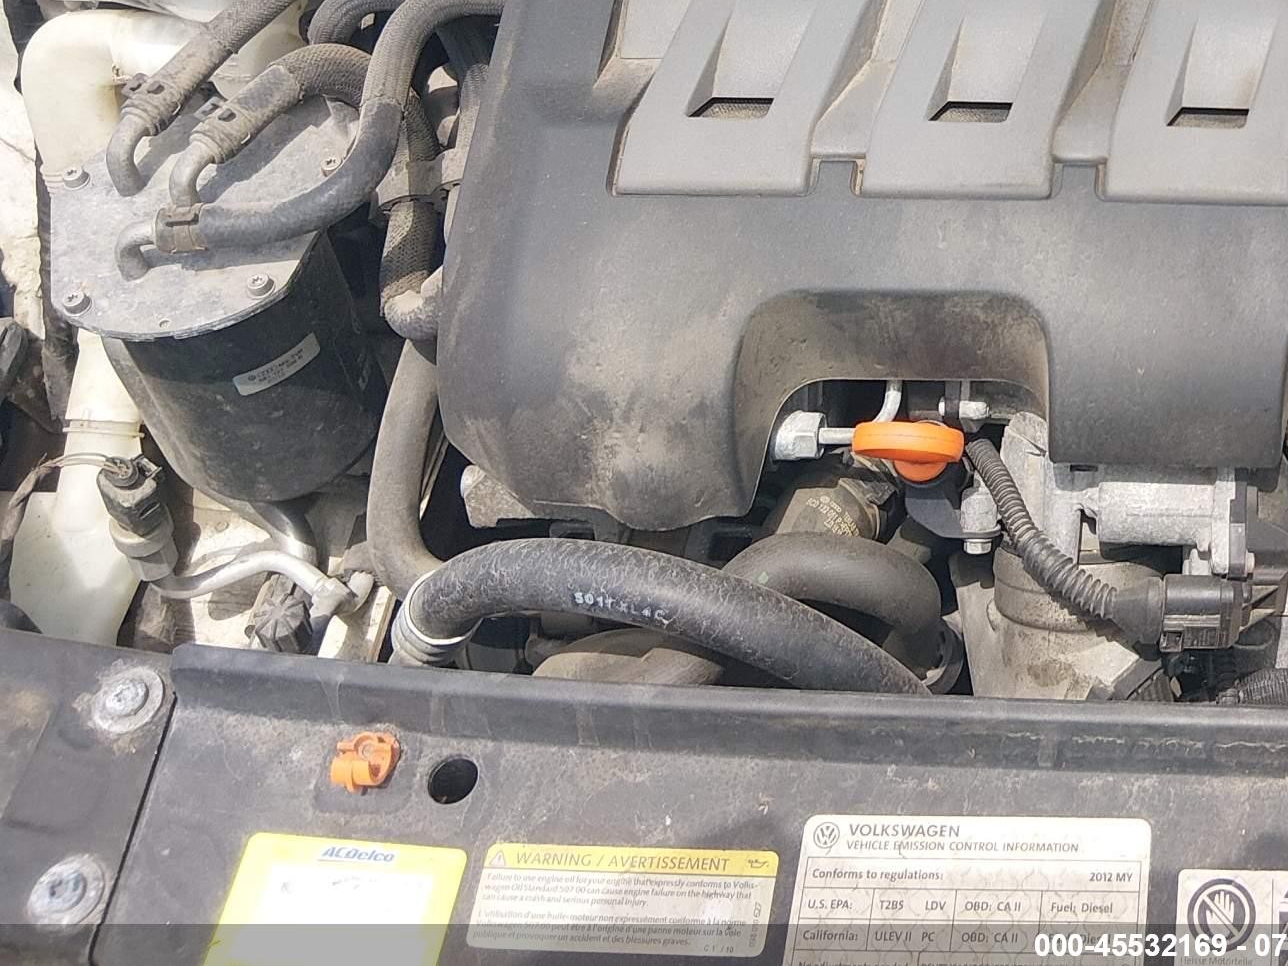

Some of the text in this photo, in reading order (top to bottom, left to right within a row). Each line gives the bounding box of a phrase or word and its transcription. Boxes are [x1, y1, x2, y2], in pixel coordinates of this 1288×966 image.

[849, 824, 960, 837] VOLKSWAGEN
[847, 840, 1079, 852] VEHICLE EMISSION CONTROL INFORMATION
[321, 847, 395, 862] ACDelco
[516, 852, 730, 872] WARNING / AVERTISSEMENT
[812, 868, 943, 882] Conforms to regulations:
[1089, 872, 1133, 882] 2012 MY
[537, 874, 564, 885] engine
[686, 879, 722, 888] conforms
[724, 880, 730, 888] to
[624, 888, 650, 898] engine
[651, 889, 675, 897] failure
[701, 890, 734, 900] highway
[736, 891, 752, 899] that
[590, 896, 624, 906] personal
[624, 897, 648, 907] injury.
[808, 899, 852, 910] U.S. EPA:
[925, 900, 946, 911] LDV
[964, 901, 1021, 912] OBD: CA II
[1051, 902, 1113, 914] Fuel: Diesel
[626, 925, 647, 933] d'une
[648, 928, 671, 936] panne
[673, 927, 702, 935] moteur
[803, 930, 858, 941] California:
[570, 933, 601, 942] accident
[626, 936, 662, 944] blessures
[662, 939, 690, 947] graves.
[875, 931, 935, 942] ULEV II PC
[962, 933, 1018, 943] OBD: CA II
